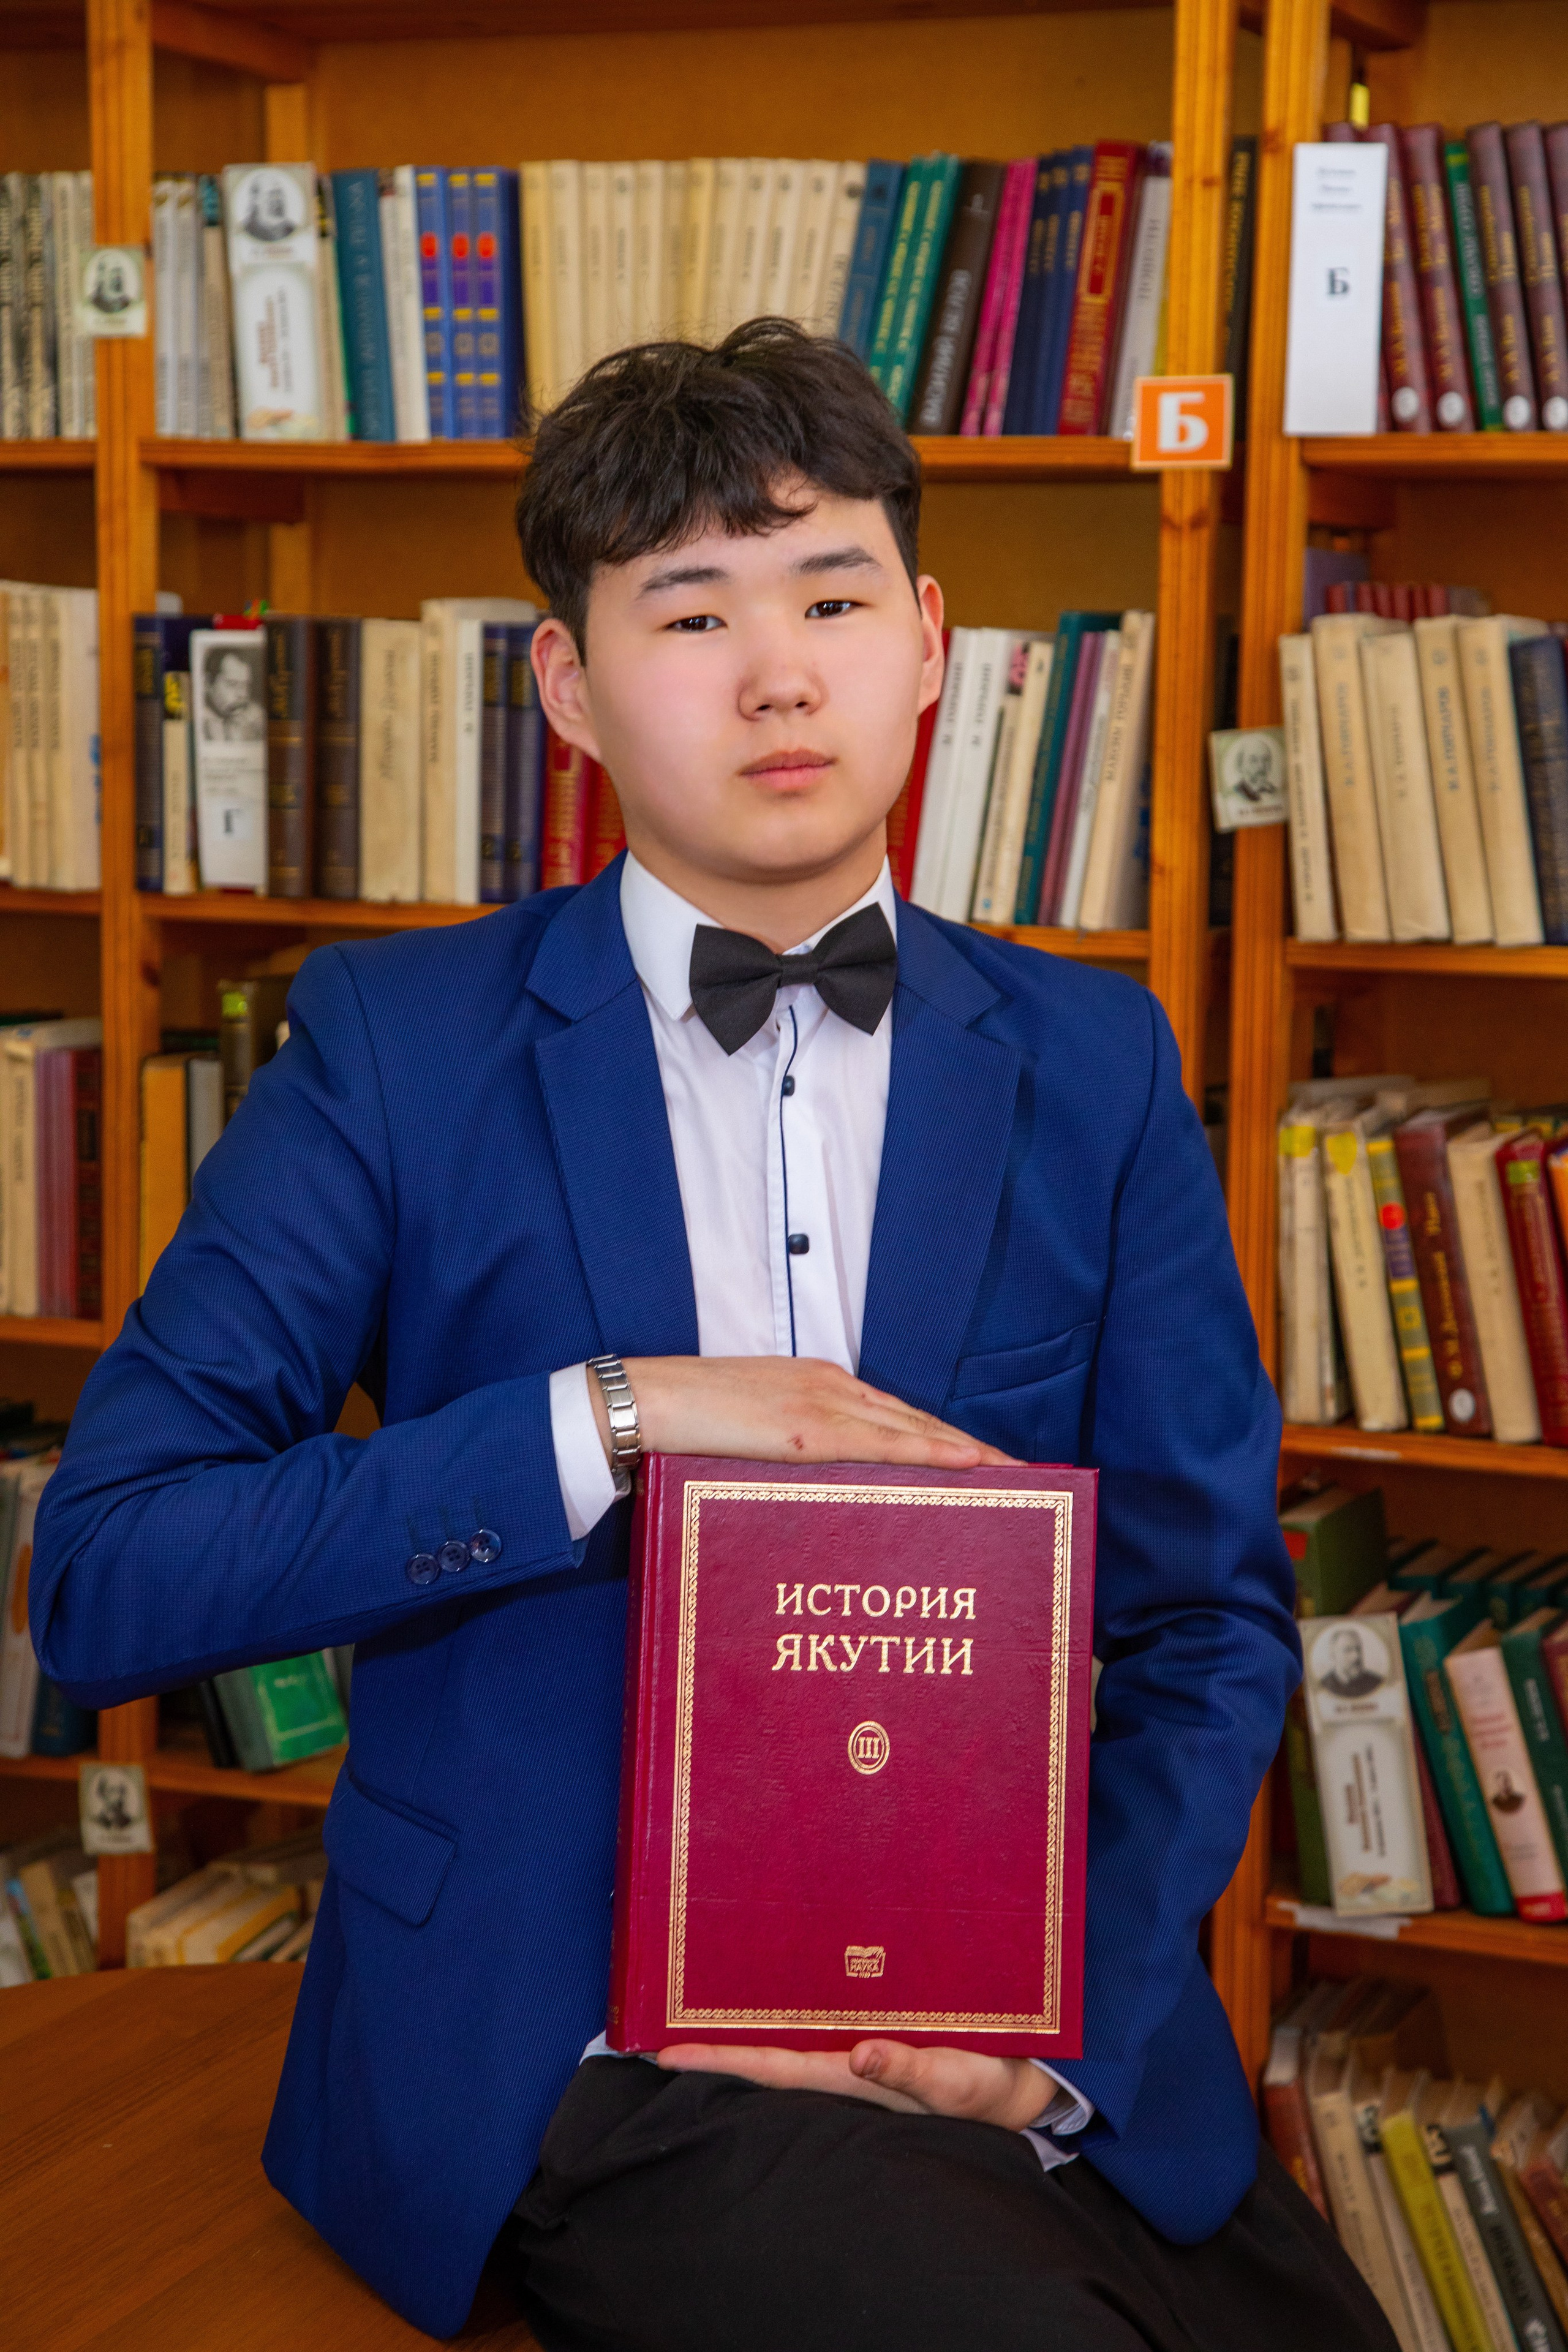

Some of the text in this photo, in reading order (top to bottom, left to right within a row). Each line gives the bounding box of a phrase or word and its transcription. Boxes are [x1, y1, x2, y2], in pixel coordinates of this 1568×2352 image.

[1327, 266, 1350, 295] Б
[921, 268, 971, 426] ВАСИЛИЙ БЕЛОВ
[1157, 391, 1209, 453] Б
[222, 808, 243, 834] Г
[775, 1583, 976, 1619] ИСТОРИЯ
[772, 1634, 974, 1675] ЯКУТИИ
[857, 1736, 881, 1759] III
[850, 1962, 880, 1972] НАУКА
